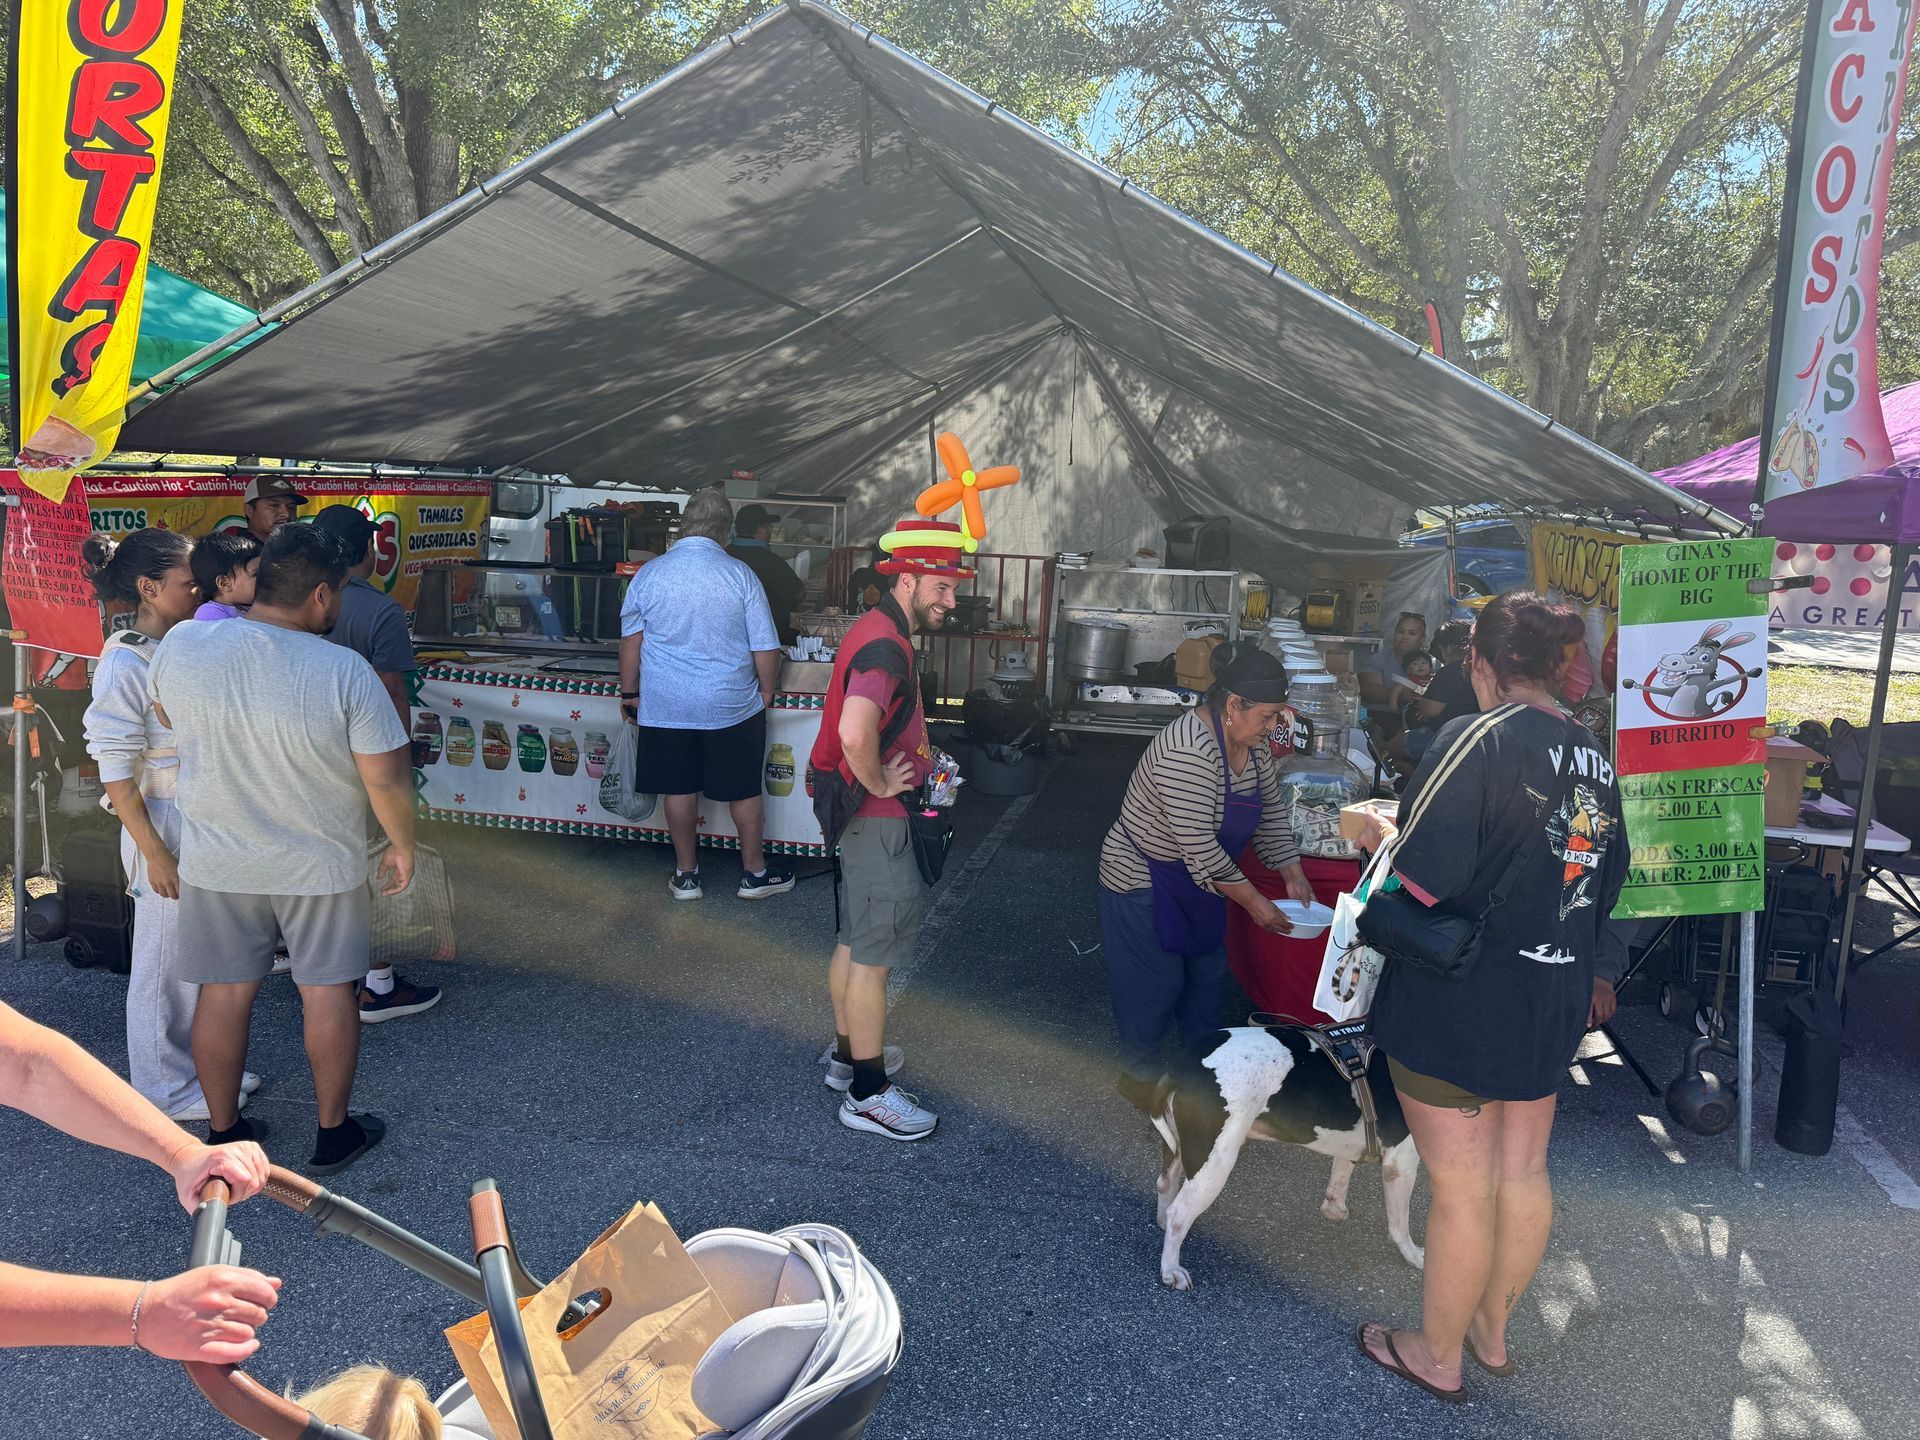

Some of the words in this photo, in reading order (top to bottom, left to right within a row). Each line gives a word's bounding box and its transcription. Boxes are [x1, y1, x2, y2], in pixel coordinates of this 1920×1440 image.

[162, 480, 184, 492] Hot
[229, 480, 247, 491] Hot
[343, 480, 358, 490] Hot
[392, 481, 406, 491] Hot
[437, 482, 449, 492] Hot
[418, 507, 464, 524] TAMALES
[409, 531, 477, 551] QUESADILLAS
[1665, 543, 1732, 562] GINA'S
[1630, 567, 1690, 587] HOME
[1695, 565, 1721, 582] OF
[1725, 562, 1762, 580] THE
[8, 588, 40, 600] STREET
[1680, 588, 1713, 606] BIG
[1768, 605, 1786, 623] A
[1649, 723, 1735, 746] BURRITO
[1621, 780, 1676, 798] GUAS
[1682, 776, 1764, 795] FRESCAS
[1658, 801, 1691, 818] 5.00
[1696, 800, 1722, 816] EA
[1631, 844, 1689, 863] ODAS:
[1695, 842, 1728, 859] 3.00
[1733, 840, 1758, 857] EA
[1698, 863, 1731, 880] 2.00
[1736, 862, 1761, 878] EA
[1329, 1029, 1341, 1037] IN
